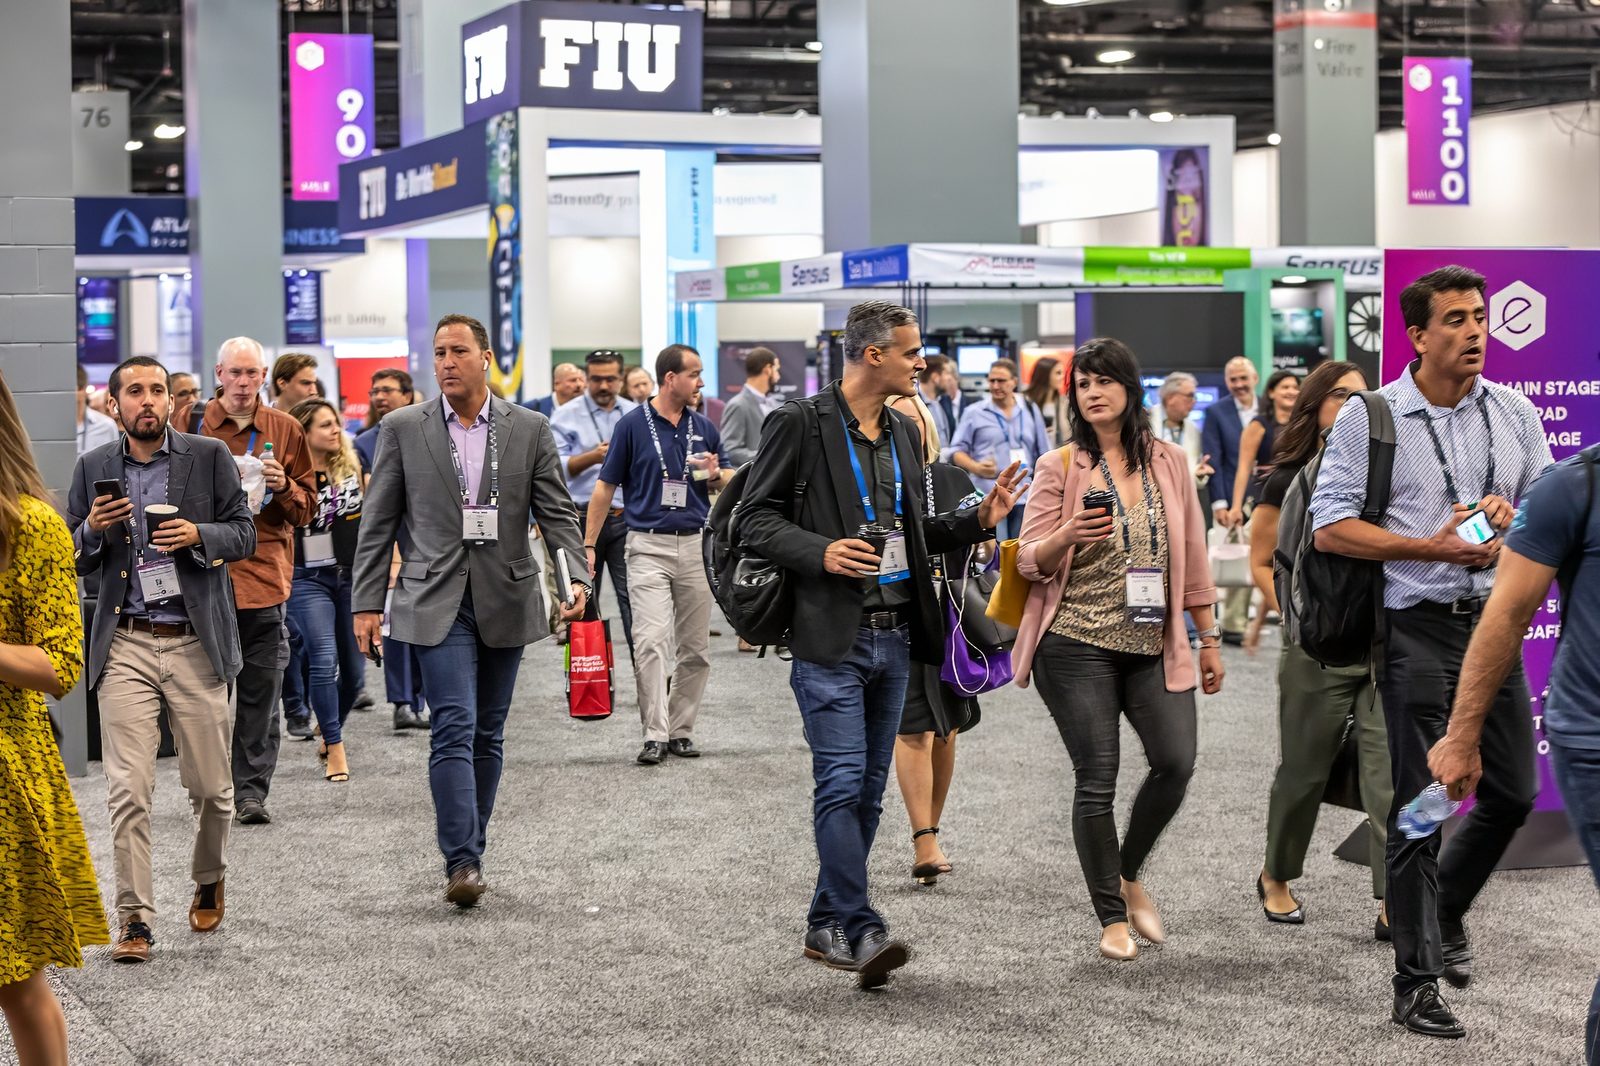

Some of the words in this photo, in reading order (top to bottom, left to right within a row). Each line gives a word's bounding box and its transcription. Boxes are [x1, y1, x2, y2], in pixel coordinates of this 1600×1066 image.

[540, 19, 681, 93] FIU
[80, 107, 111, 128] 76
[1440, 75, 1465, 201] 1100
[283, 228, 340, 246] INESS
[792, 264, 830, 287] Sensus
[1545, 381, 1600, 396] STAGE
[1544, 431, 1582, 446] AGE
